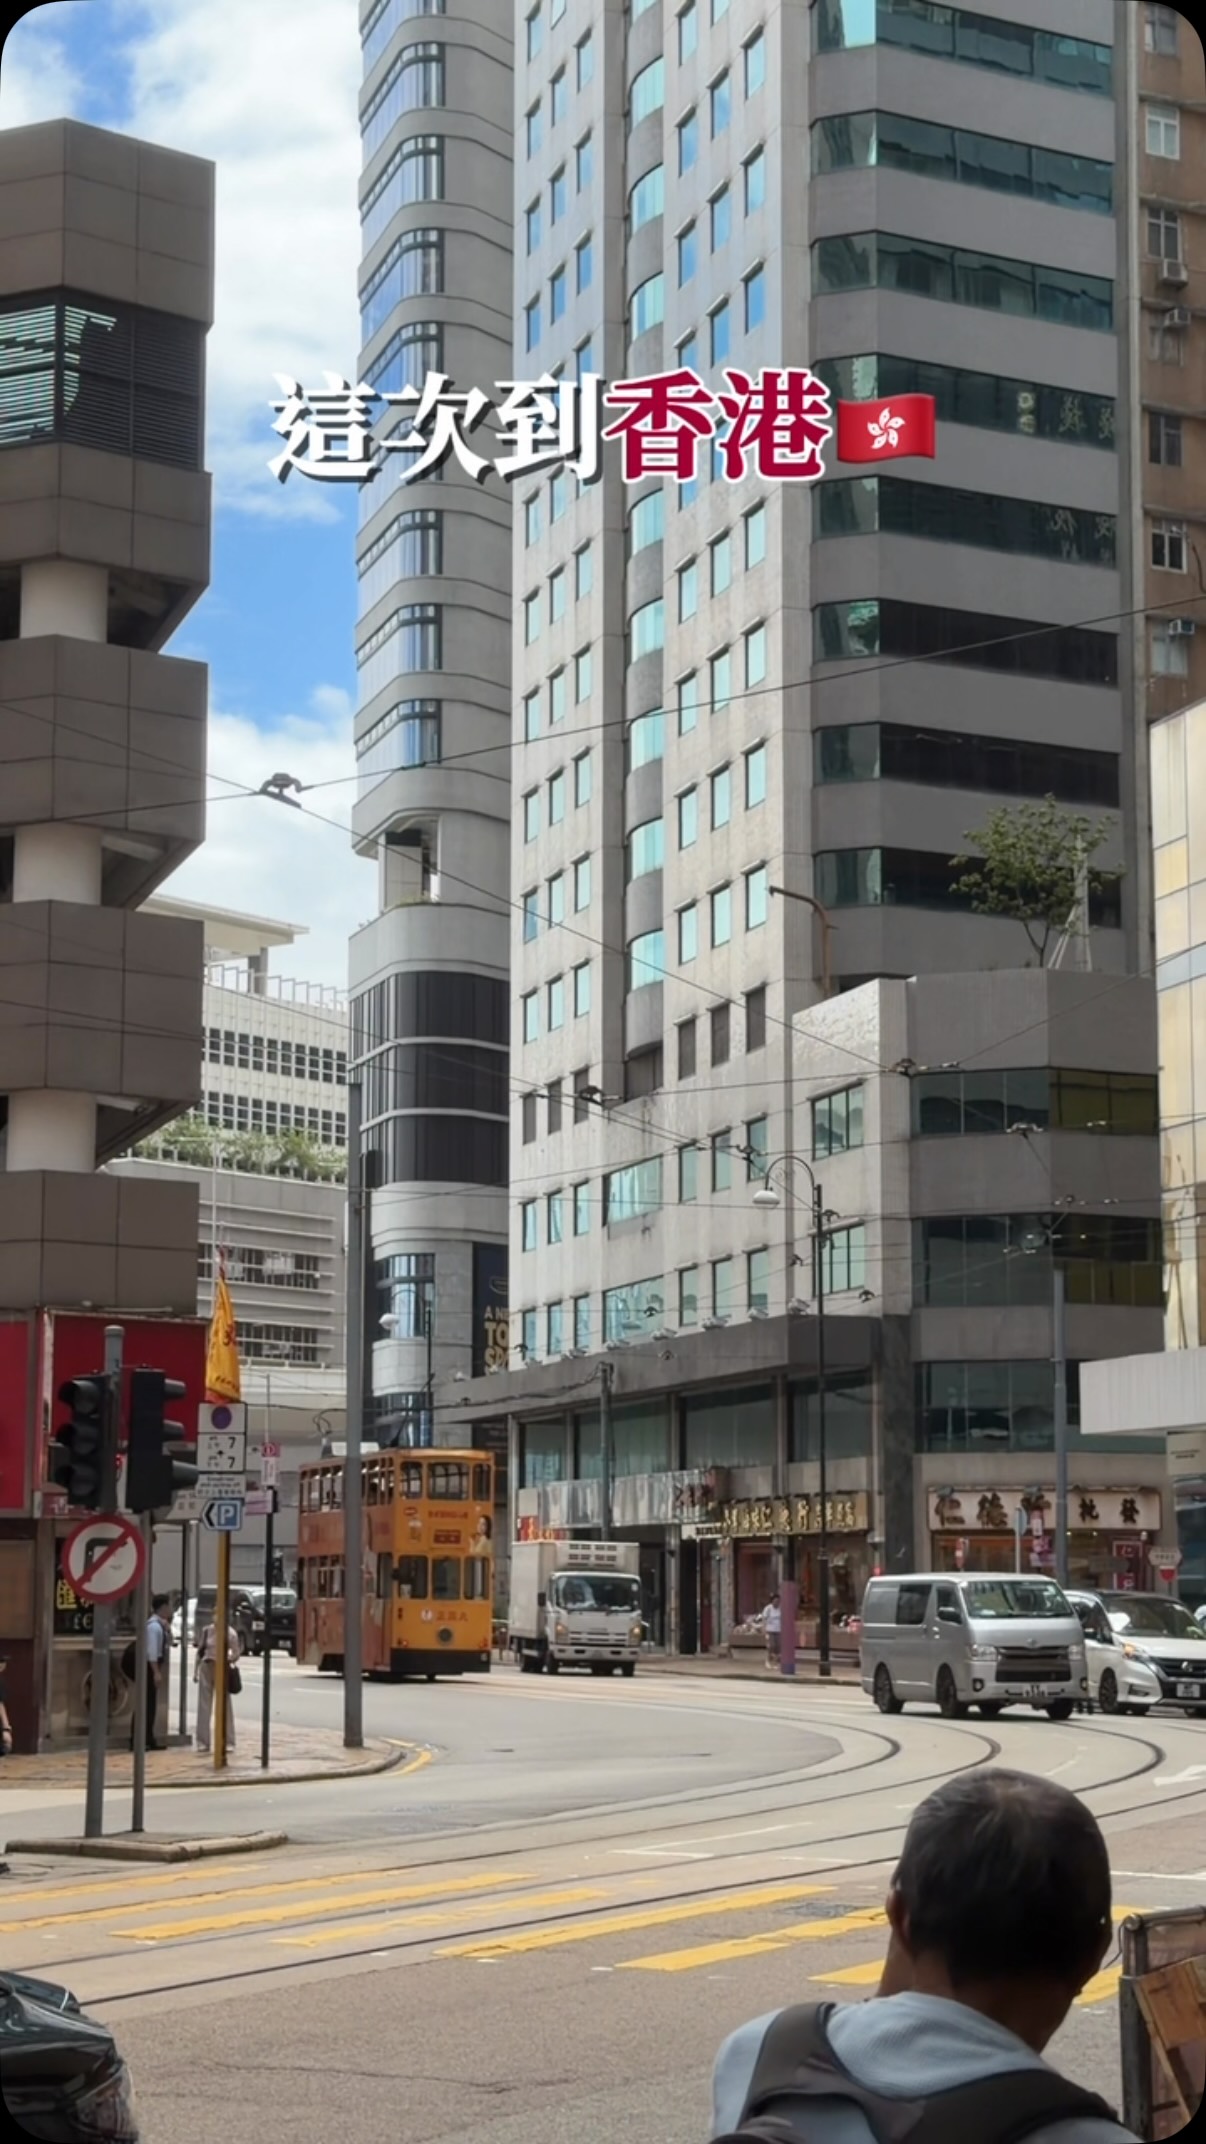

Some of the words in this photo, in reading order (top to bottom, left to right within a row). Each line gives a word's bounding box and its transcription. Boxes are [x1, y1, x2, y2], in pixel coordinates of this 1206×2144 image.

[228, 1436, 236, 1449] 7
[228, 1456, 235, 1468] 7
[220, 1503, 235, 1525] P
